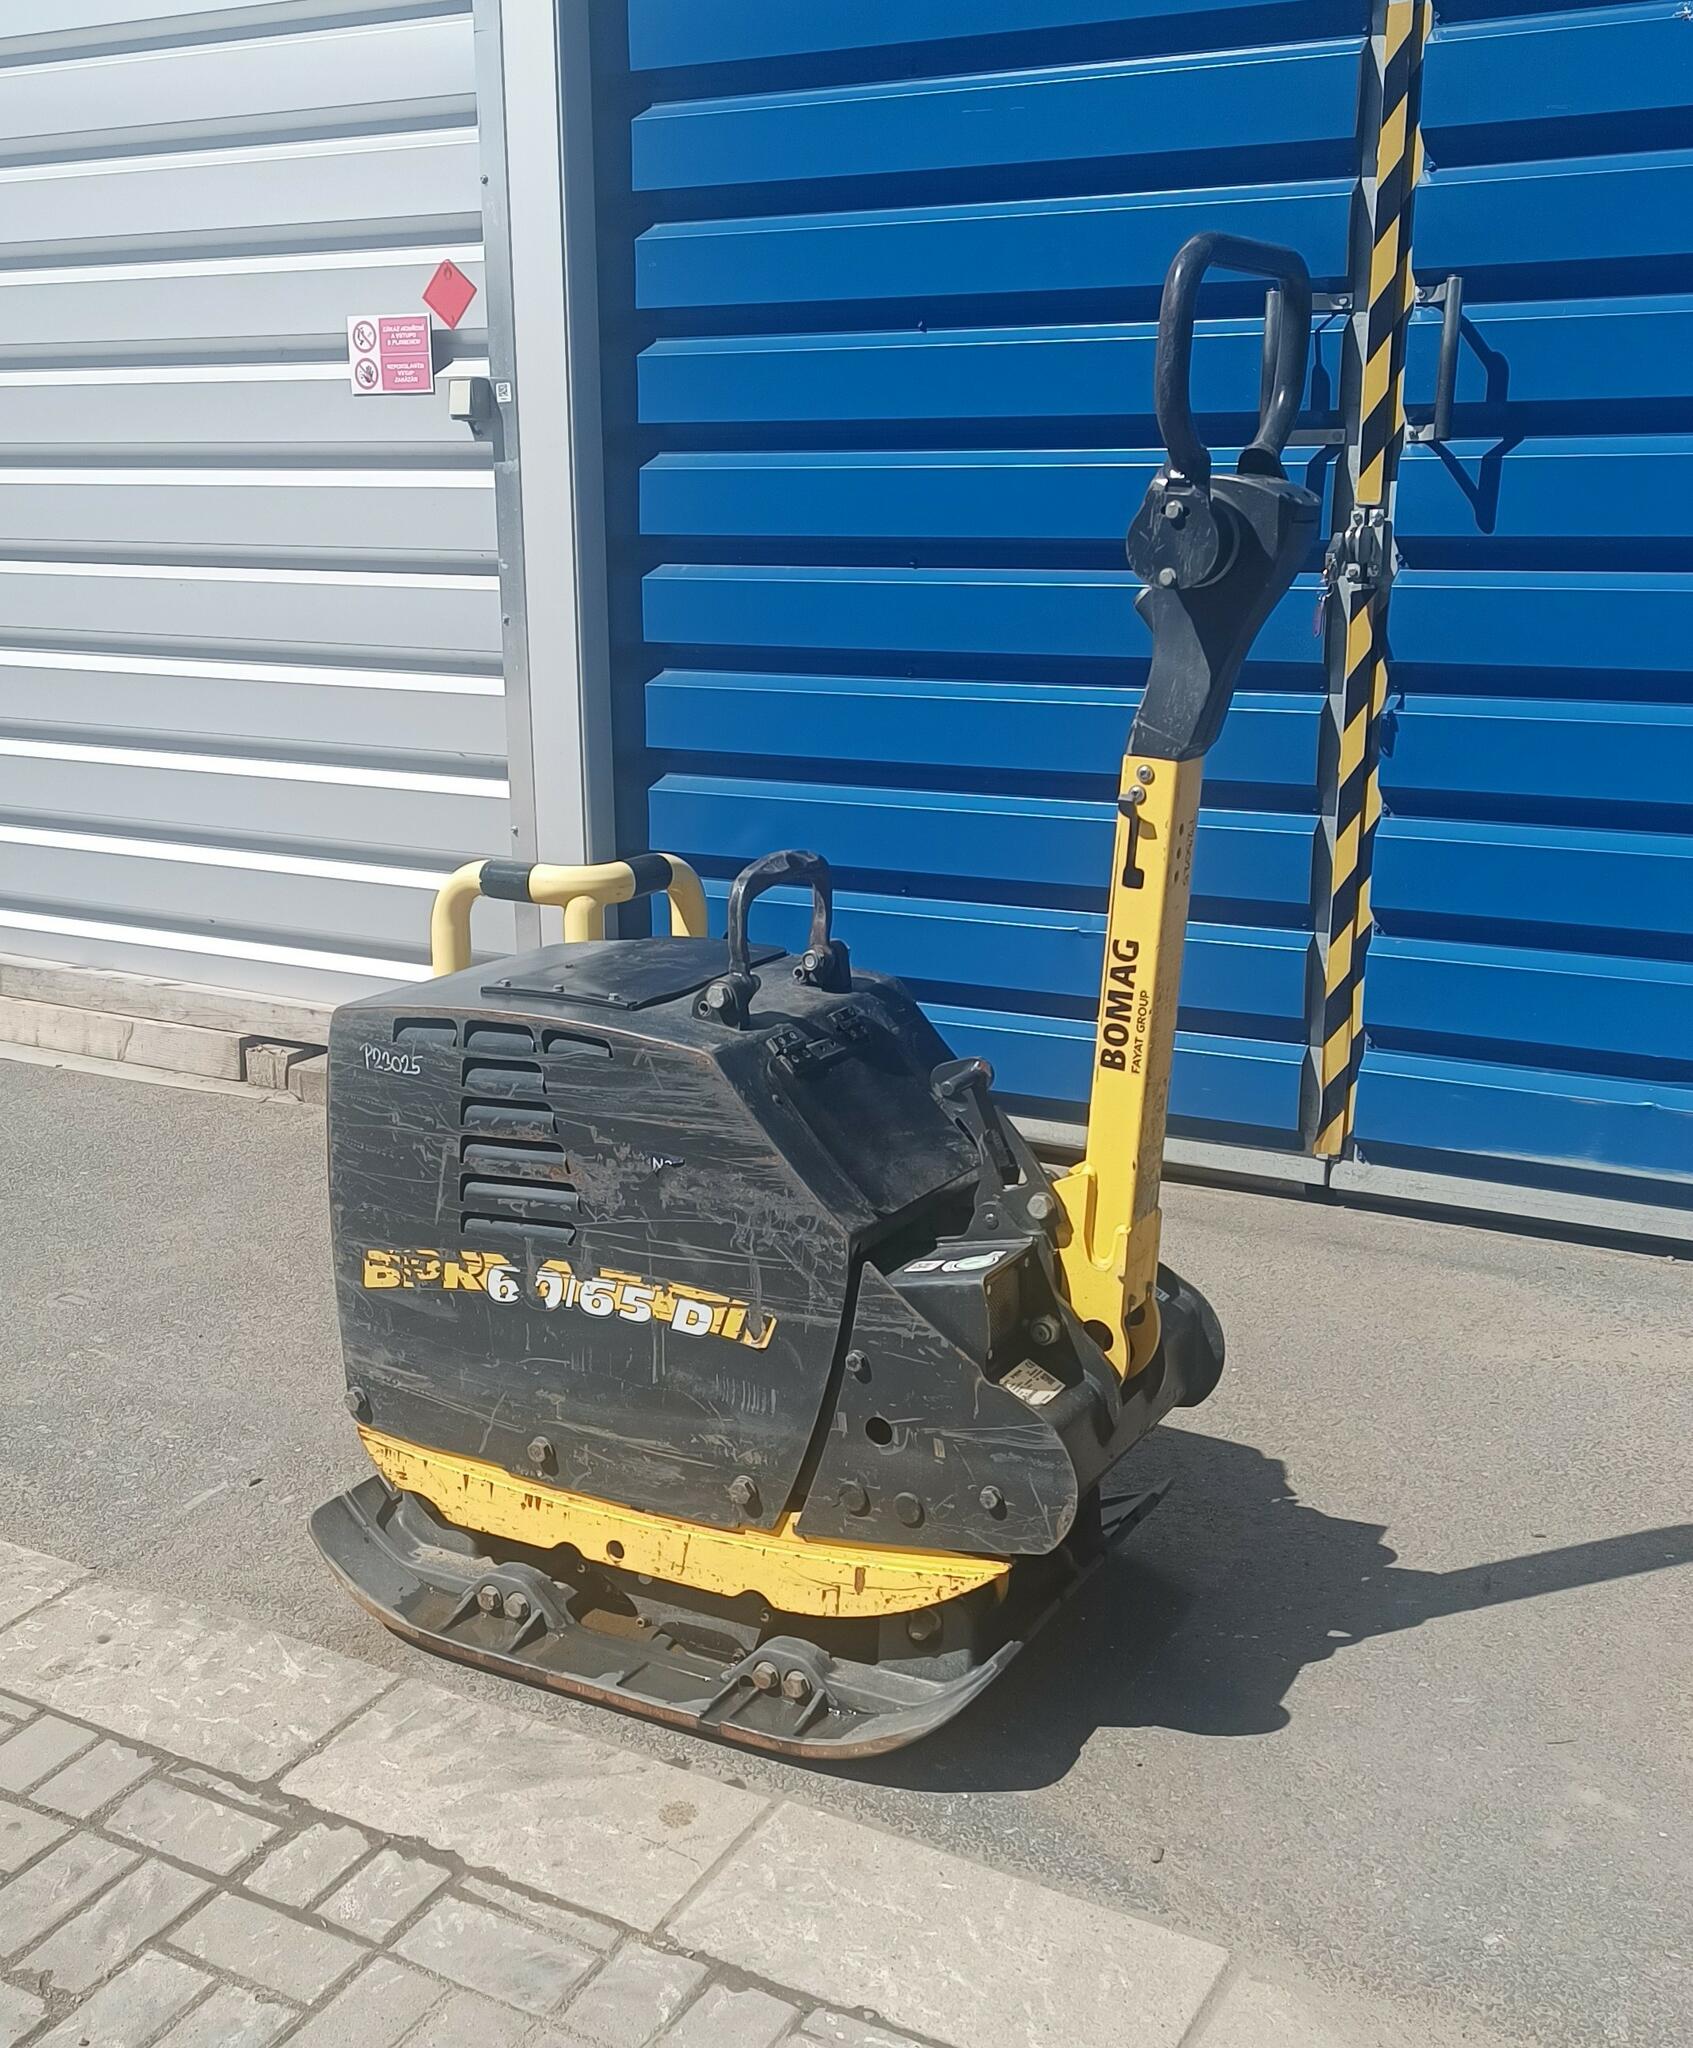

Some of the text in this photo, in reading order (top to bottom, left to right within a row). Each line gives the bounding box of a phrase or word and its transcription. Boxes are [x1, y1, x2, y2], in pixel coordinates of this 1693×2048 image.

[1100, 939, 1139, 1072] BOMAG
[1131, 990, 1150, 1074] FAYAT GROUP
[360, 1042, 423, 1075] P23025
